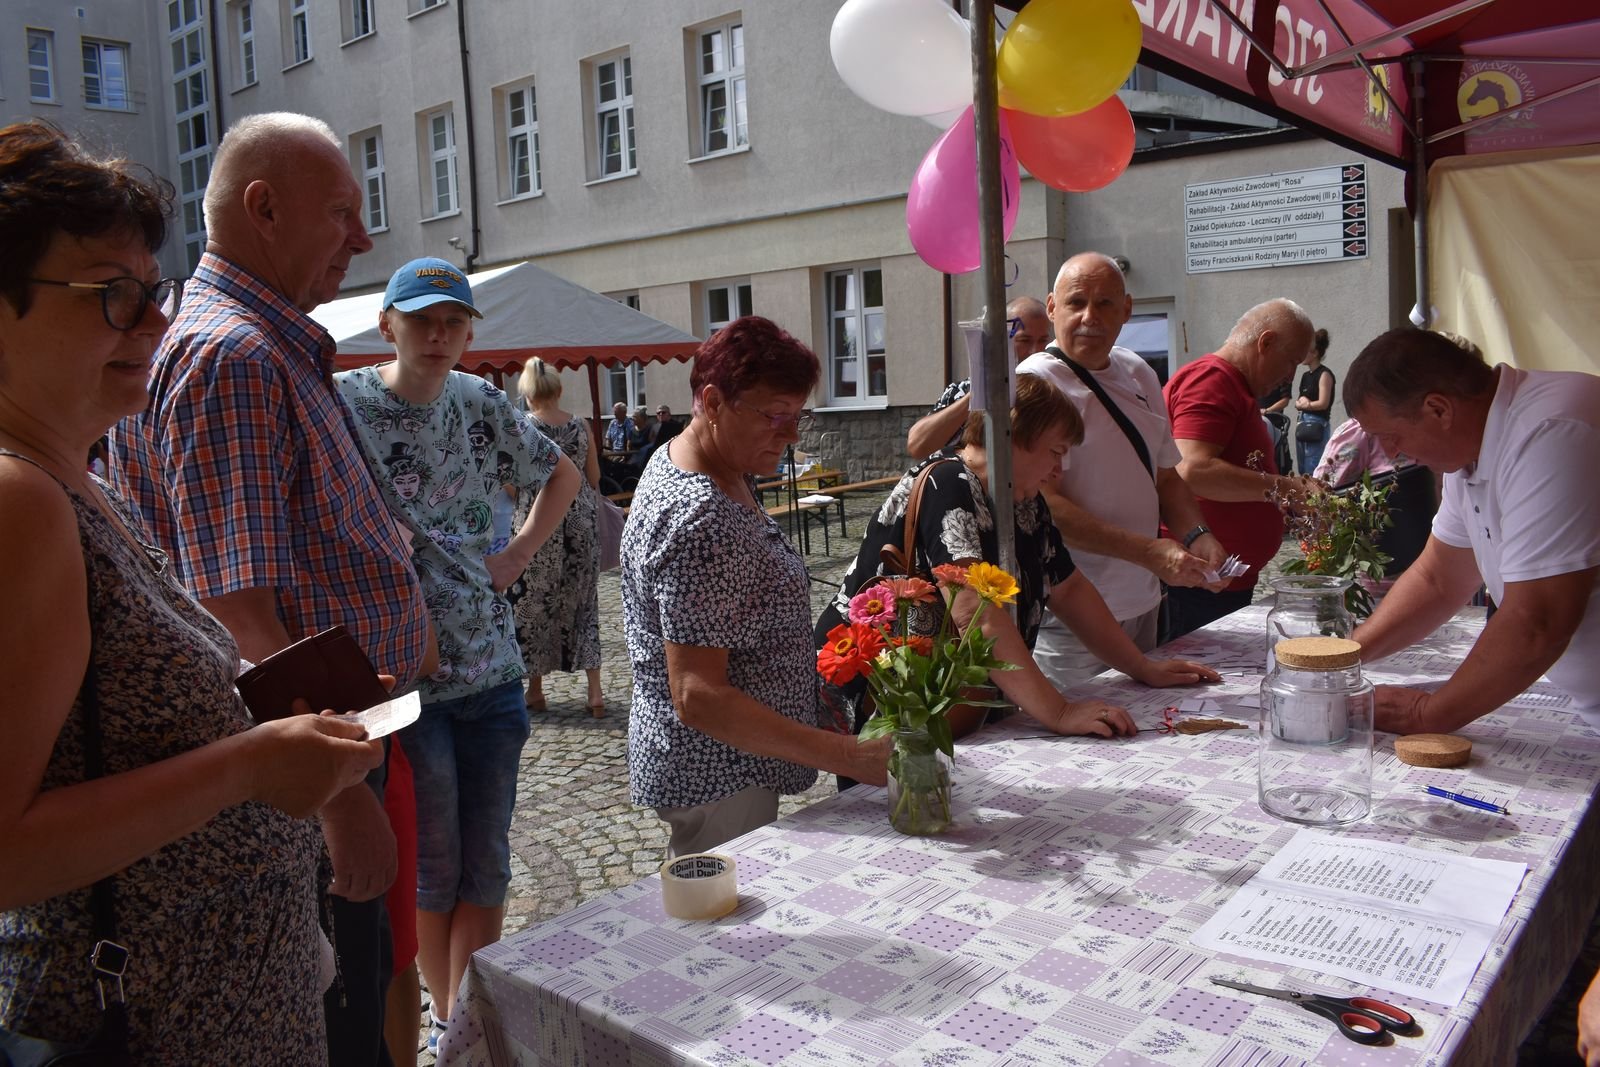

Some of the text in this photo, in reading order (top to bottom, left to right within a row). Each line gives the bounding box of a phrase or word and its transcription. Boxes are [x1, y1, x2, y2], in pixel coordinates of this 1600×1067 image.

[1188, 190, 1208, 198] Zakład
[1210, 184, 1244, 196] Aktywności
[1246, 181, 1280, 191] Zawodowej
[1190, 204, 1226, 216] Rehabilitacja
[1230, 202, 1250, 210] Zakład
[1251, 197, 1285, 208] Aktywności
[1287, 193, 1320, 203] Zawodowej
[1190, 224, 1209, 232] Zakład
[1211, 220, 1246, 231] Opiekuńczo
[1251, 216, 1281, 226] Leczniczy
[1283, 214, 1291, 224] (IV
[1295, 211, 1324, 220] oddziały)
[1190, 232, 1297, 249] Rehabilitacja ambulatoryjna (parter)
[1190, 258, 1211, 267] Siostry
[1212, 254, 1254, 264] Franciszkanki
[1255, 251, 1280, 260] Rodziny
[1282, 250, 1299, 259] Maryi
[1306, 247, 1327, 257] piętro)
[354, 396, 380, 406] SUPER
